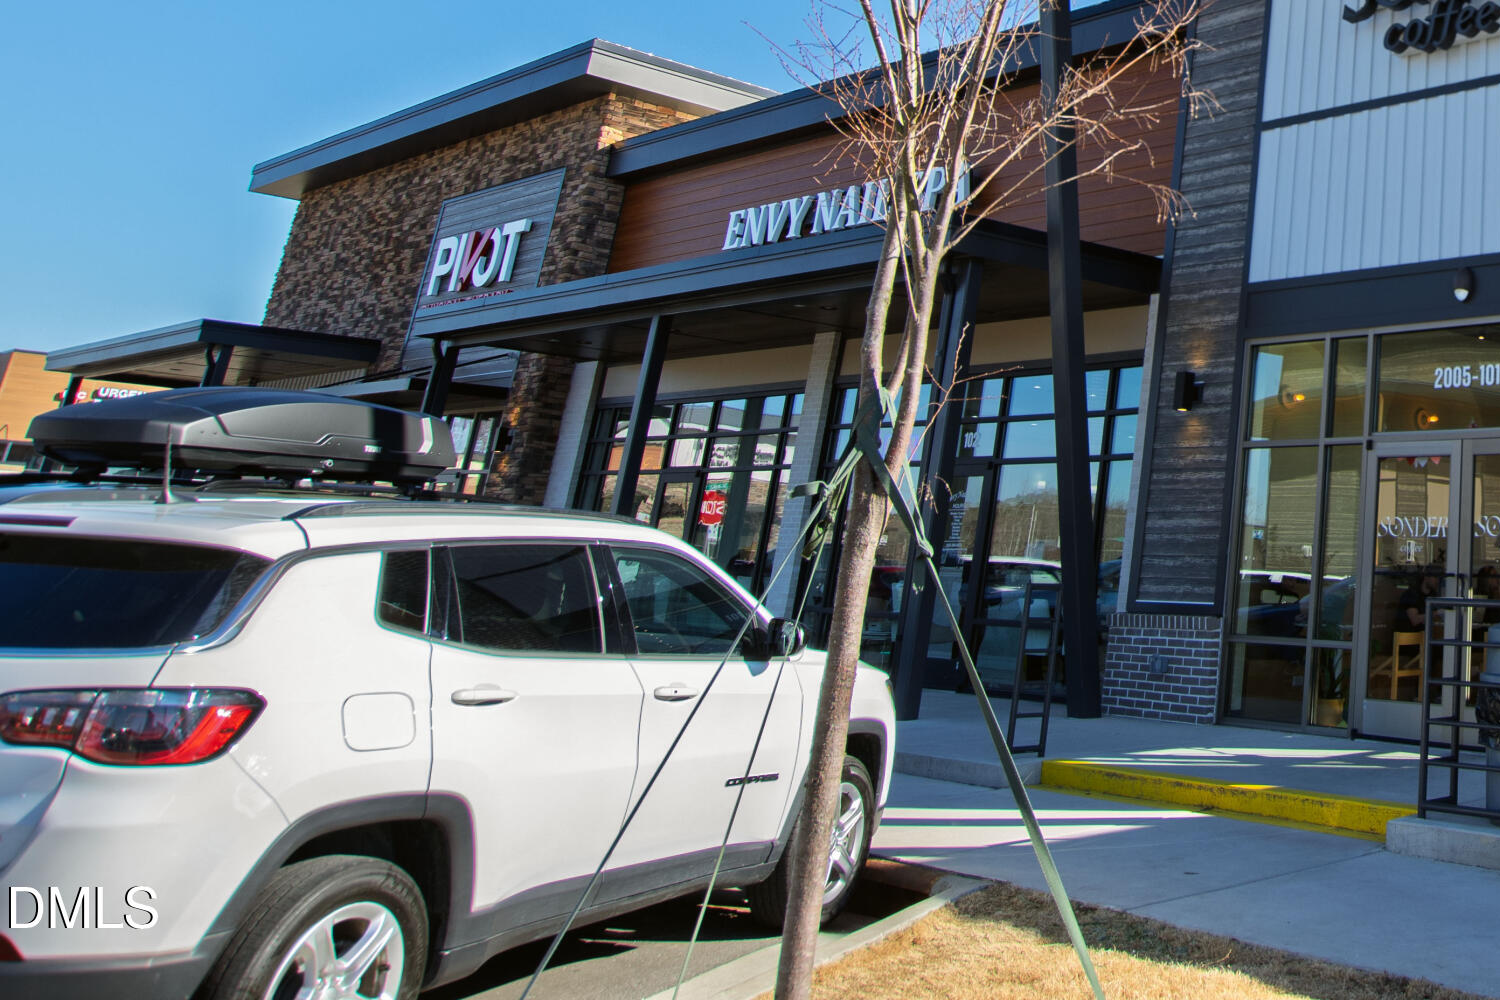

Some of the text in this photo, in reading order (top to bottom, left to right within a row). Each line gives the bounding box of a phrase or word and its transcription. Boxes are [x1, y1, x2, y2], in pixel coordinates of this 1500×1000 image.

[721, 194, 816, 251] ENVY
[905, 161, 972, 215] PA
[426, 218, 533, 297] PIVOT
[963, 431, 981, 448] 102
[1377, 516, 1448, 538] SONDER
